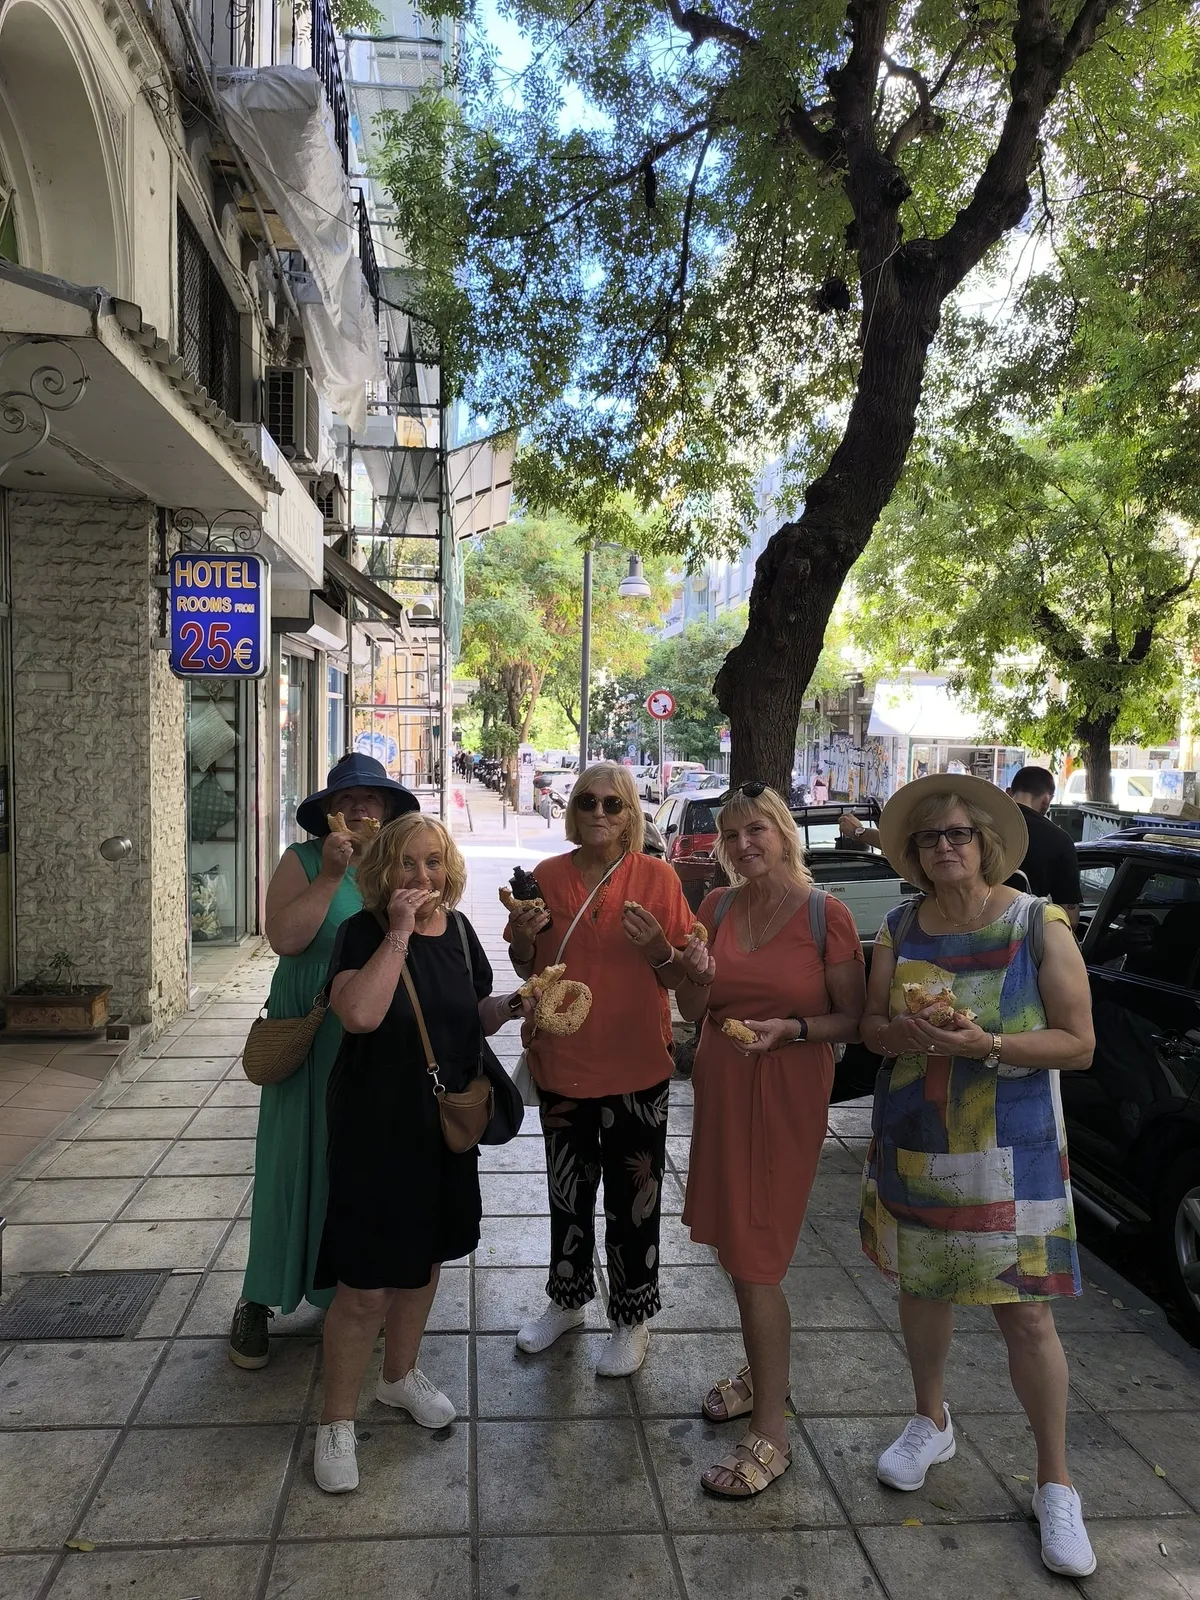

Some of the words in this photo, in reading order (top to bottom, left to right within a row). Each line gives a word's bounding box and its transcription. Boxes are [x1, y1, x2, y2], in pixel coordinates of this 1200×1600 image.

[175, 560, 257, 589] HOTEL
[176, 596, 232, 613] ROOMS
[234, 603, 255, 613] FROM
[180, 621, 254, 670] 25€
